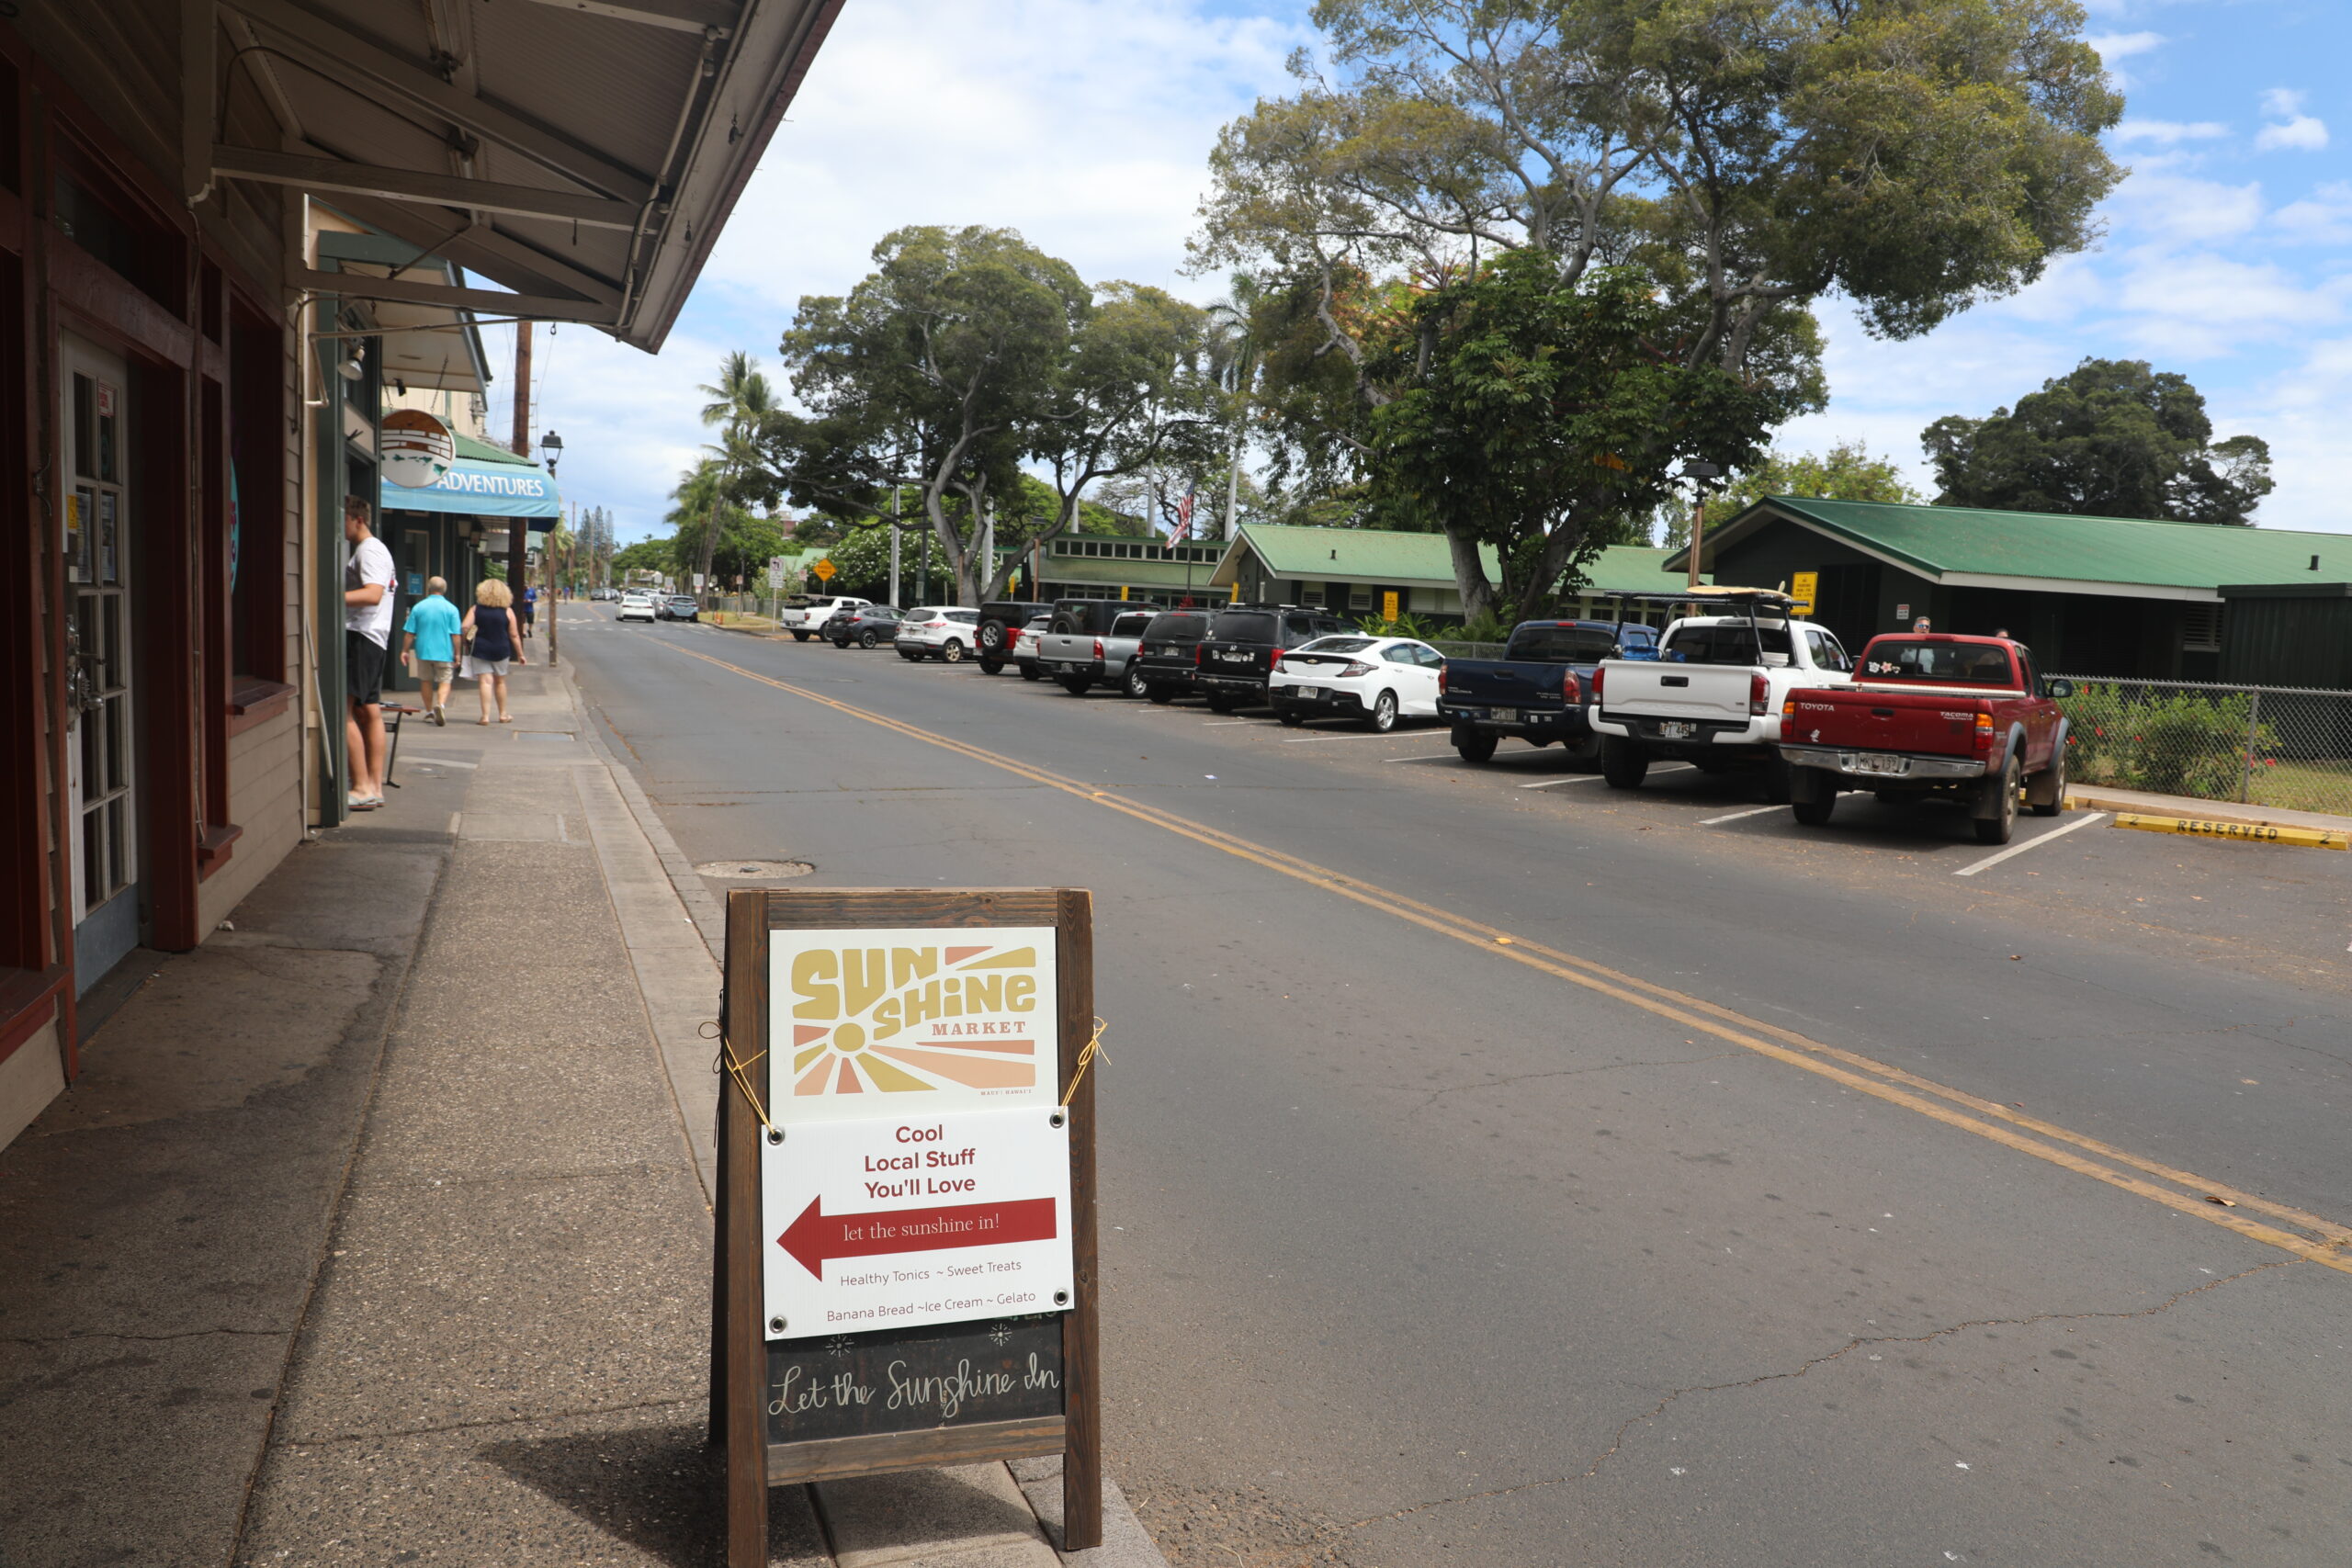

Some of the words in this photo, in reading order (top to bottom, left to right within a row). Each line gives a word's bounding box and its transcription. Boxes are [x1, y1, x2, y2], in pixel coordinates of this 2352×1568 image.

[436, 472, 544, 497] ADVENTURES
[1800, 702, 1835, 712] TOYOTA
[2129, 816, 2140, 826] 2
[2177, 819, 2278, 840] RESERVED
[2319, 830, 2331, 845] 2
[791, 946, 938, 1020] SUN
[932, 1020, 1027, 1036] MARKET
[895, 1123, 943, 1144] Cool
[865, 1152, 919, 1172] Local
[926, 1147, 976, 1168] Stuff
[864, 1179, 920, 1199] You'll
[927, 1177, 976, 1194] Love
[843, 1224, 864, 1242] let
[869, 1222, 897, 1239] the
[901, 1216, 974, 1236] sunshine
[978, 1213, 1000, 1230] in!
[841, 1271, 889, 1287] Healthy
[892, 1269, 930, 1282] Tonics
[947, 1264, 984, 1278] Sweet
[987, 1259, 1022, 1272] Treats
[827, 1309, 875, 1322] Banana
[878, 1303, 914, 1317] Bread
[944, 1296, 983, 1311] Cream
[997, 1291, 1036, 1304] Gelato
[768, 1366, 827, 1416] Let
[831, 1372, 876, 1405] the
[888, 1359, 1016, 1418] Sunshine
[1024, 1351, 1060, 1390] In
